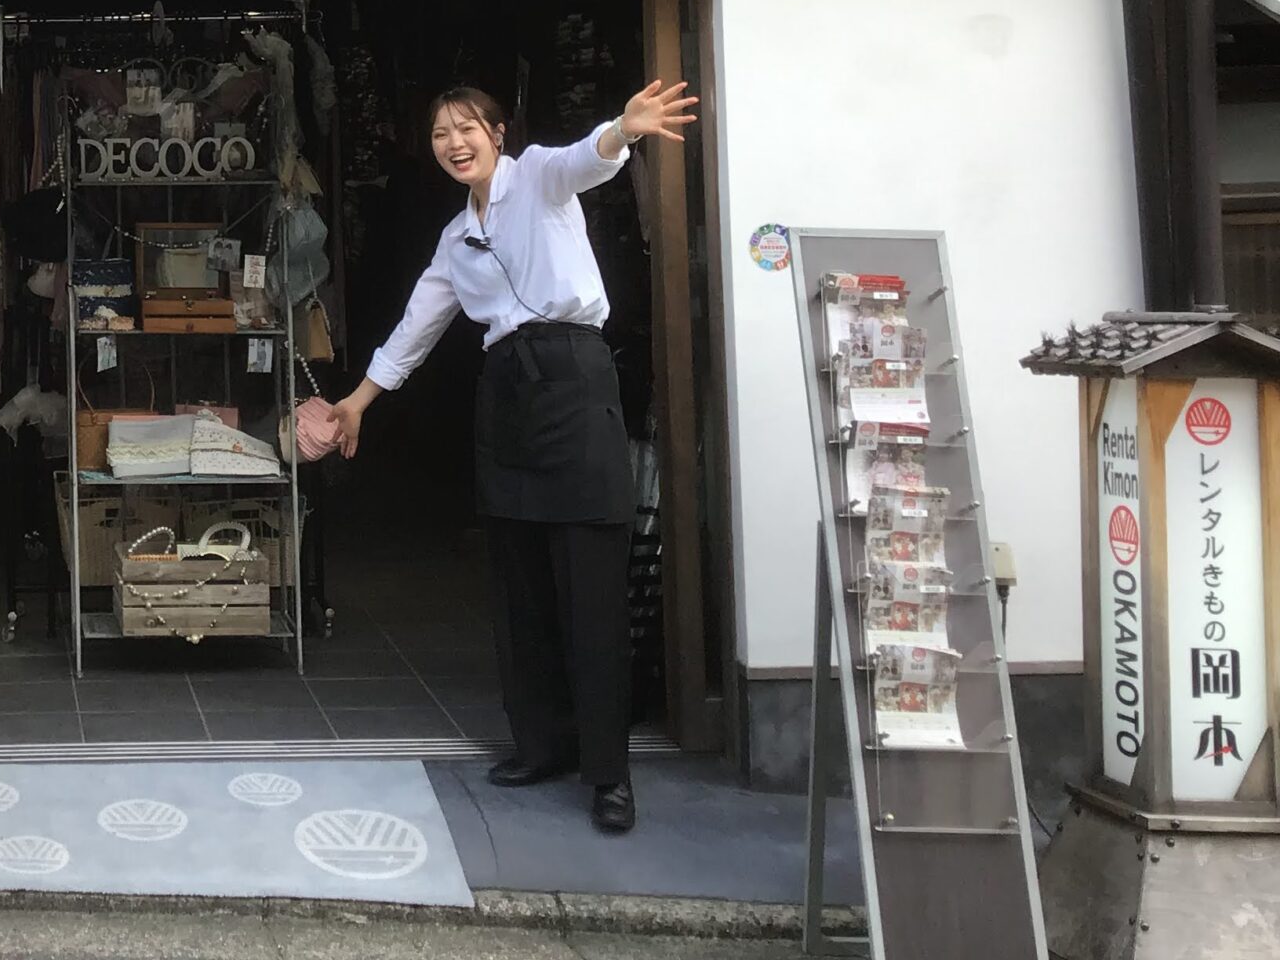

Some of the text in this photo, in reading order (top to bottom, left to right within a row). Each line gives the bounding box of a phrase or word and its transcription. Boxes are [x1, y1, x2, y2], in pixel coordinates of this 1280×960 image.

[76, 136, 256, 181] DECOCO
[1103, 422, 1139, 460] Rental
[1112, 569, 1141, 759] OKAMOTO
[1190, 452, 1243, 767] レンタルきもの岡本
